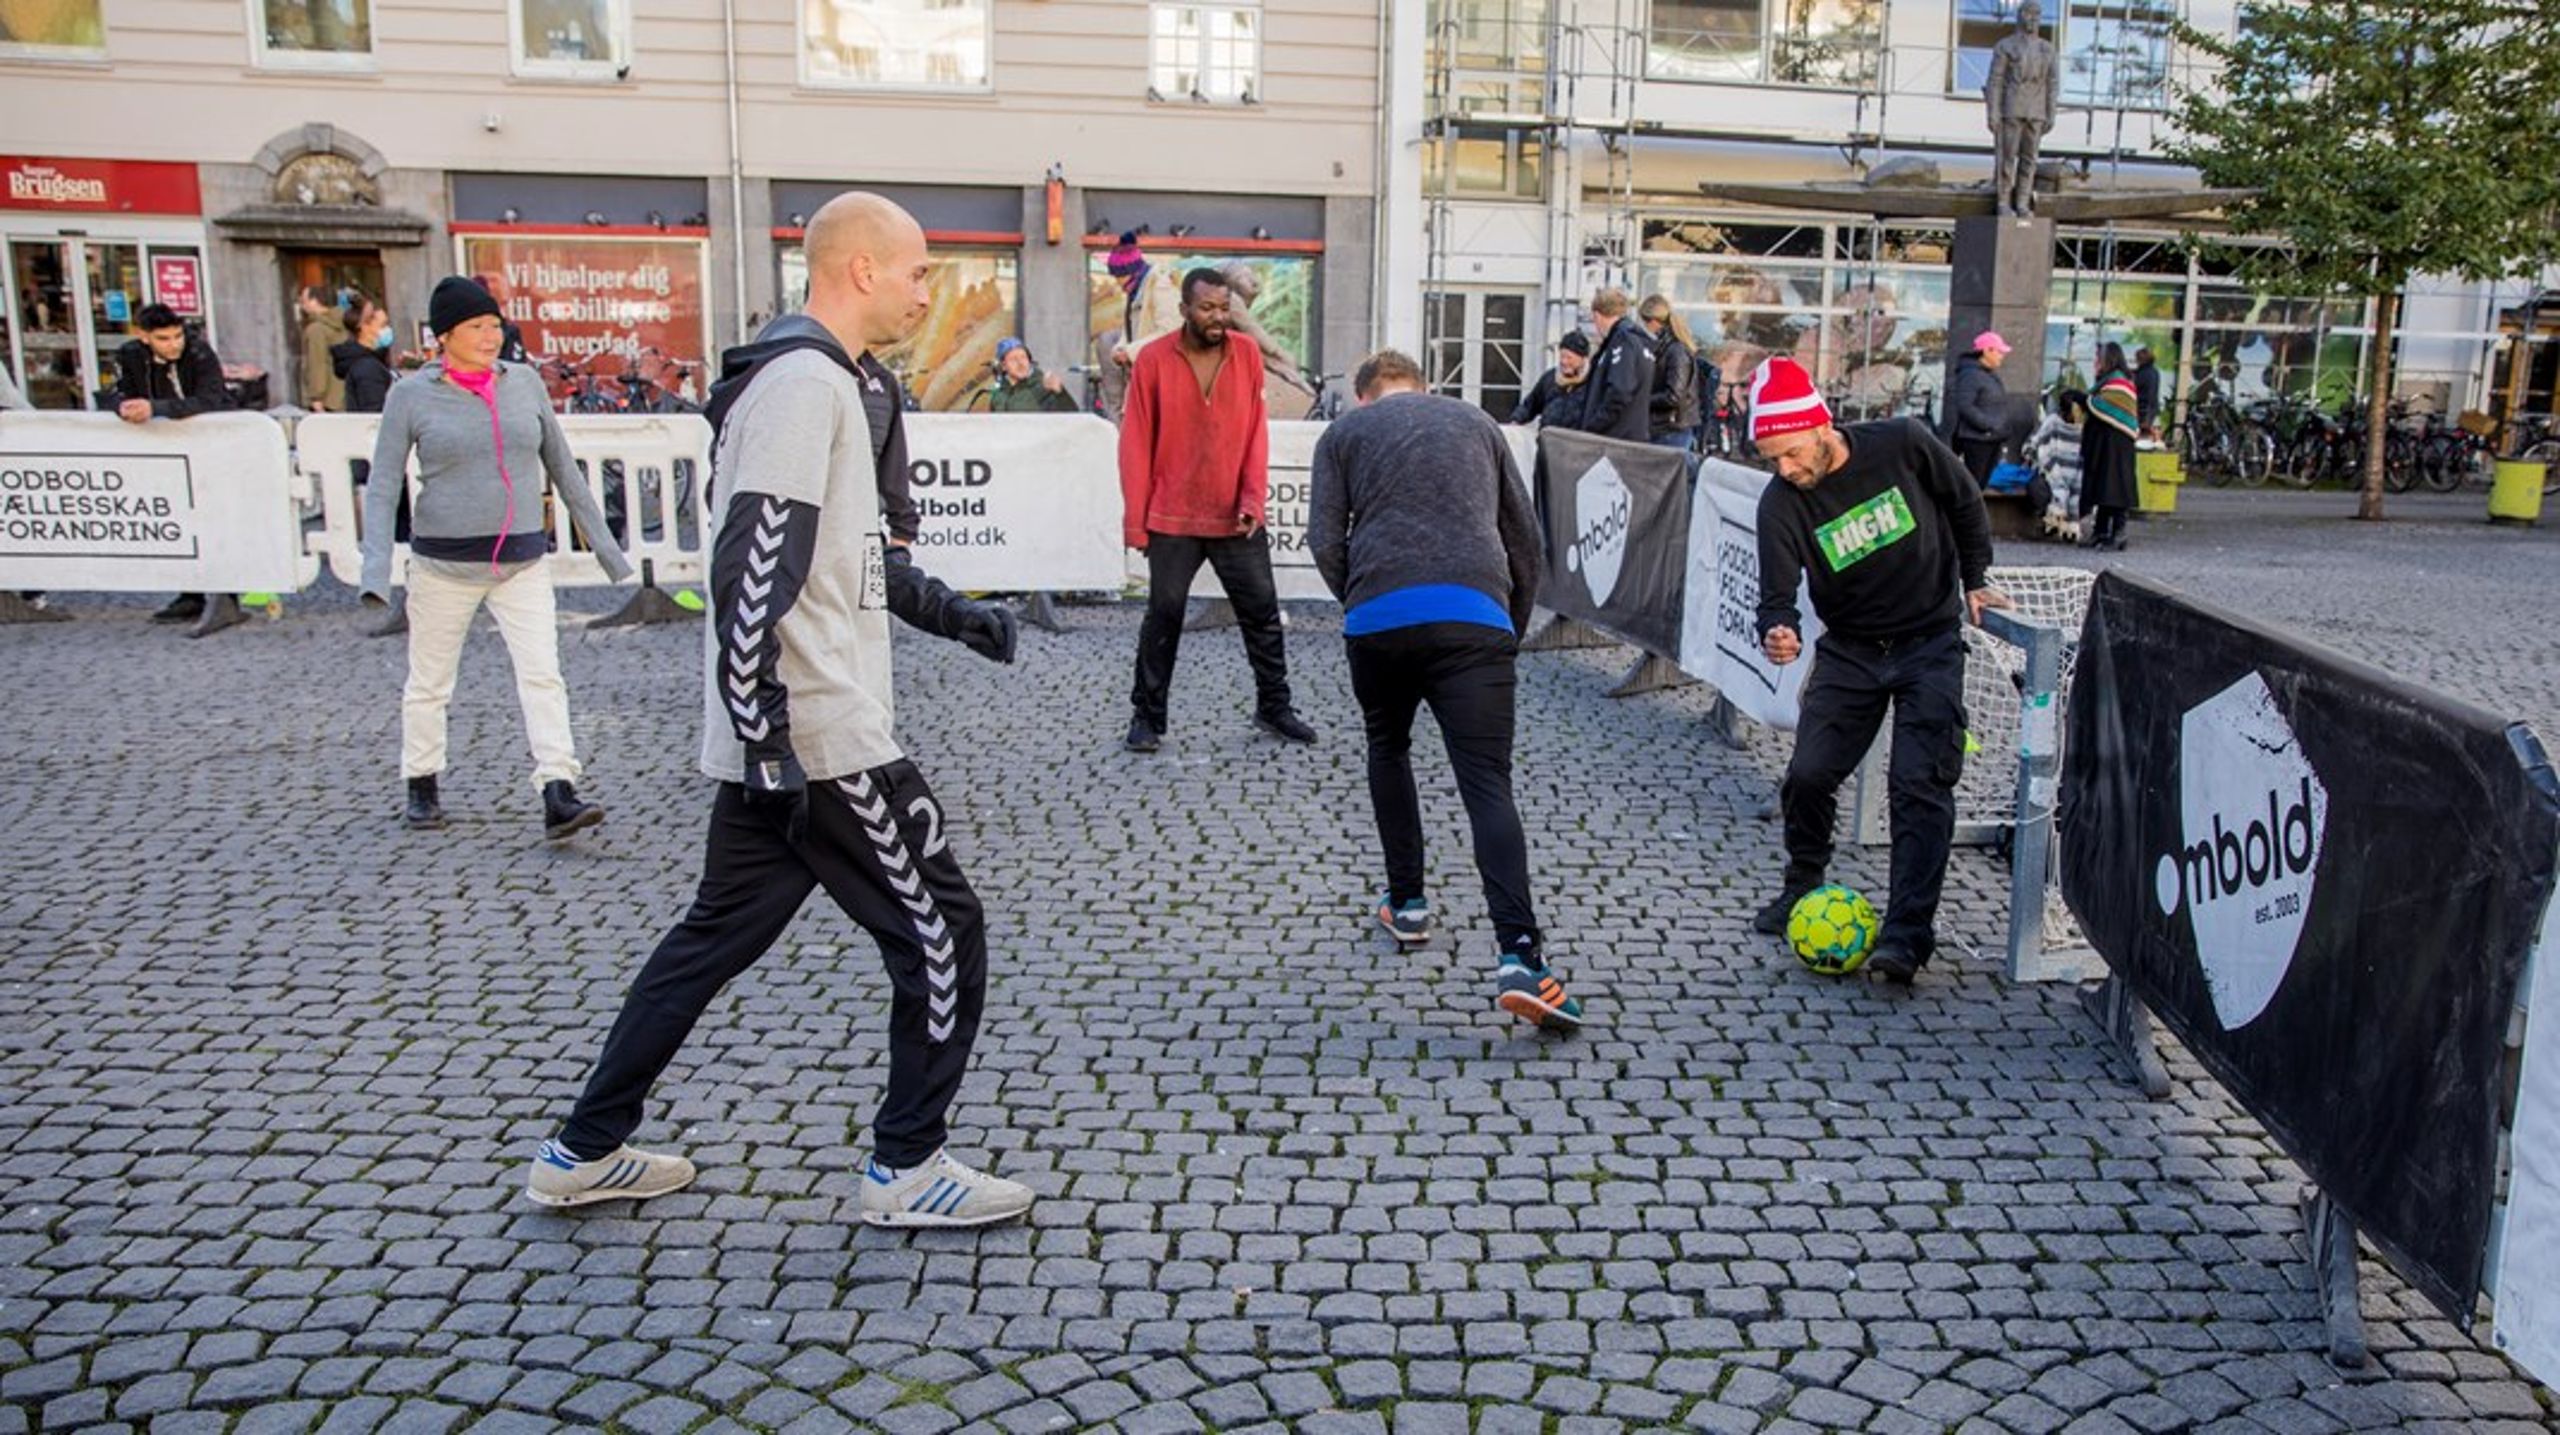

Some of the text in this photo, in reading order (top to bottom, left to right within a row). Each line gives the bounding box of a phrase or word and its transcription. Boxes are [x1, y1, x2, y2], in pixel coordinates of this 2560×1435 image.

[9, 171, 106, 202] Brugsen
[506, 263, 670, 295] Vi hjælper dig
[507, 296, 533, 321] til
[573, 296, 671, 329] billigere
[541, 329, 640, 359] hverdag
[1, 469, 124, 491] ODBOLD
[909, 459, 992, 487] OLD
[0, 494, 172, 518] ÆLLESSKAB
[914, 497, 986, 517] dbold
[916, 527, 1006, 546] bold.dk
[1566, 491, 1628, 573] ombold
[1832, 501, 1899, 558] HIGH
[908, 796, 946, 859] 2
[2156, 776, 2314, 916] ombold
[2255, 892, 2300, 925] est. 2003
